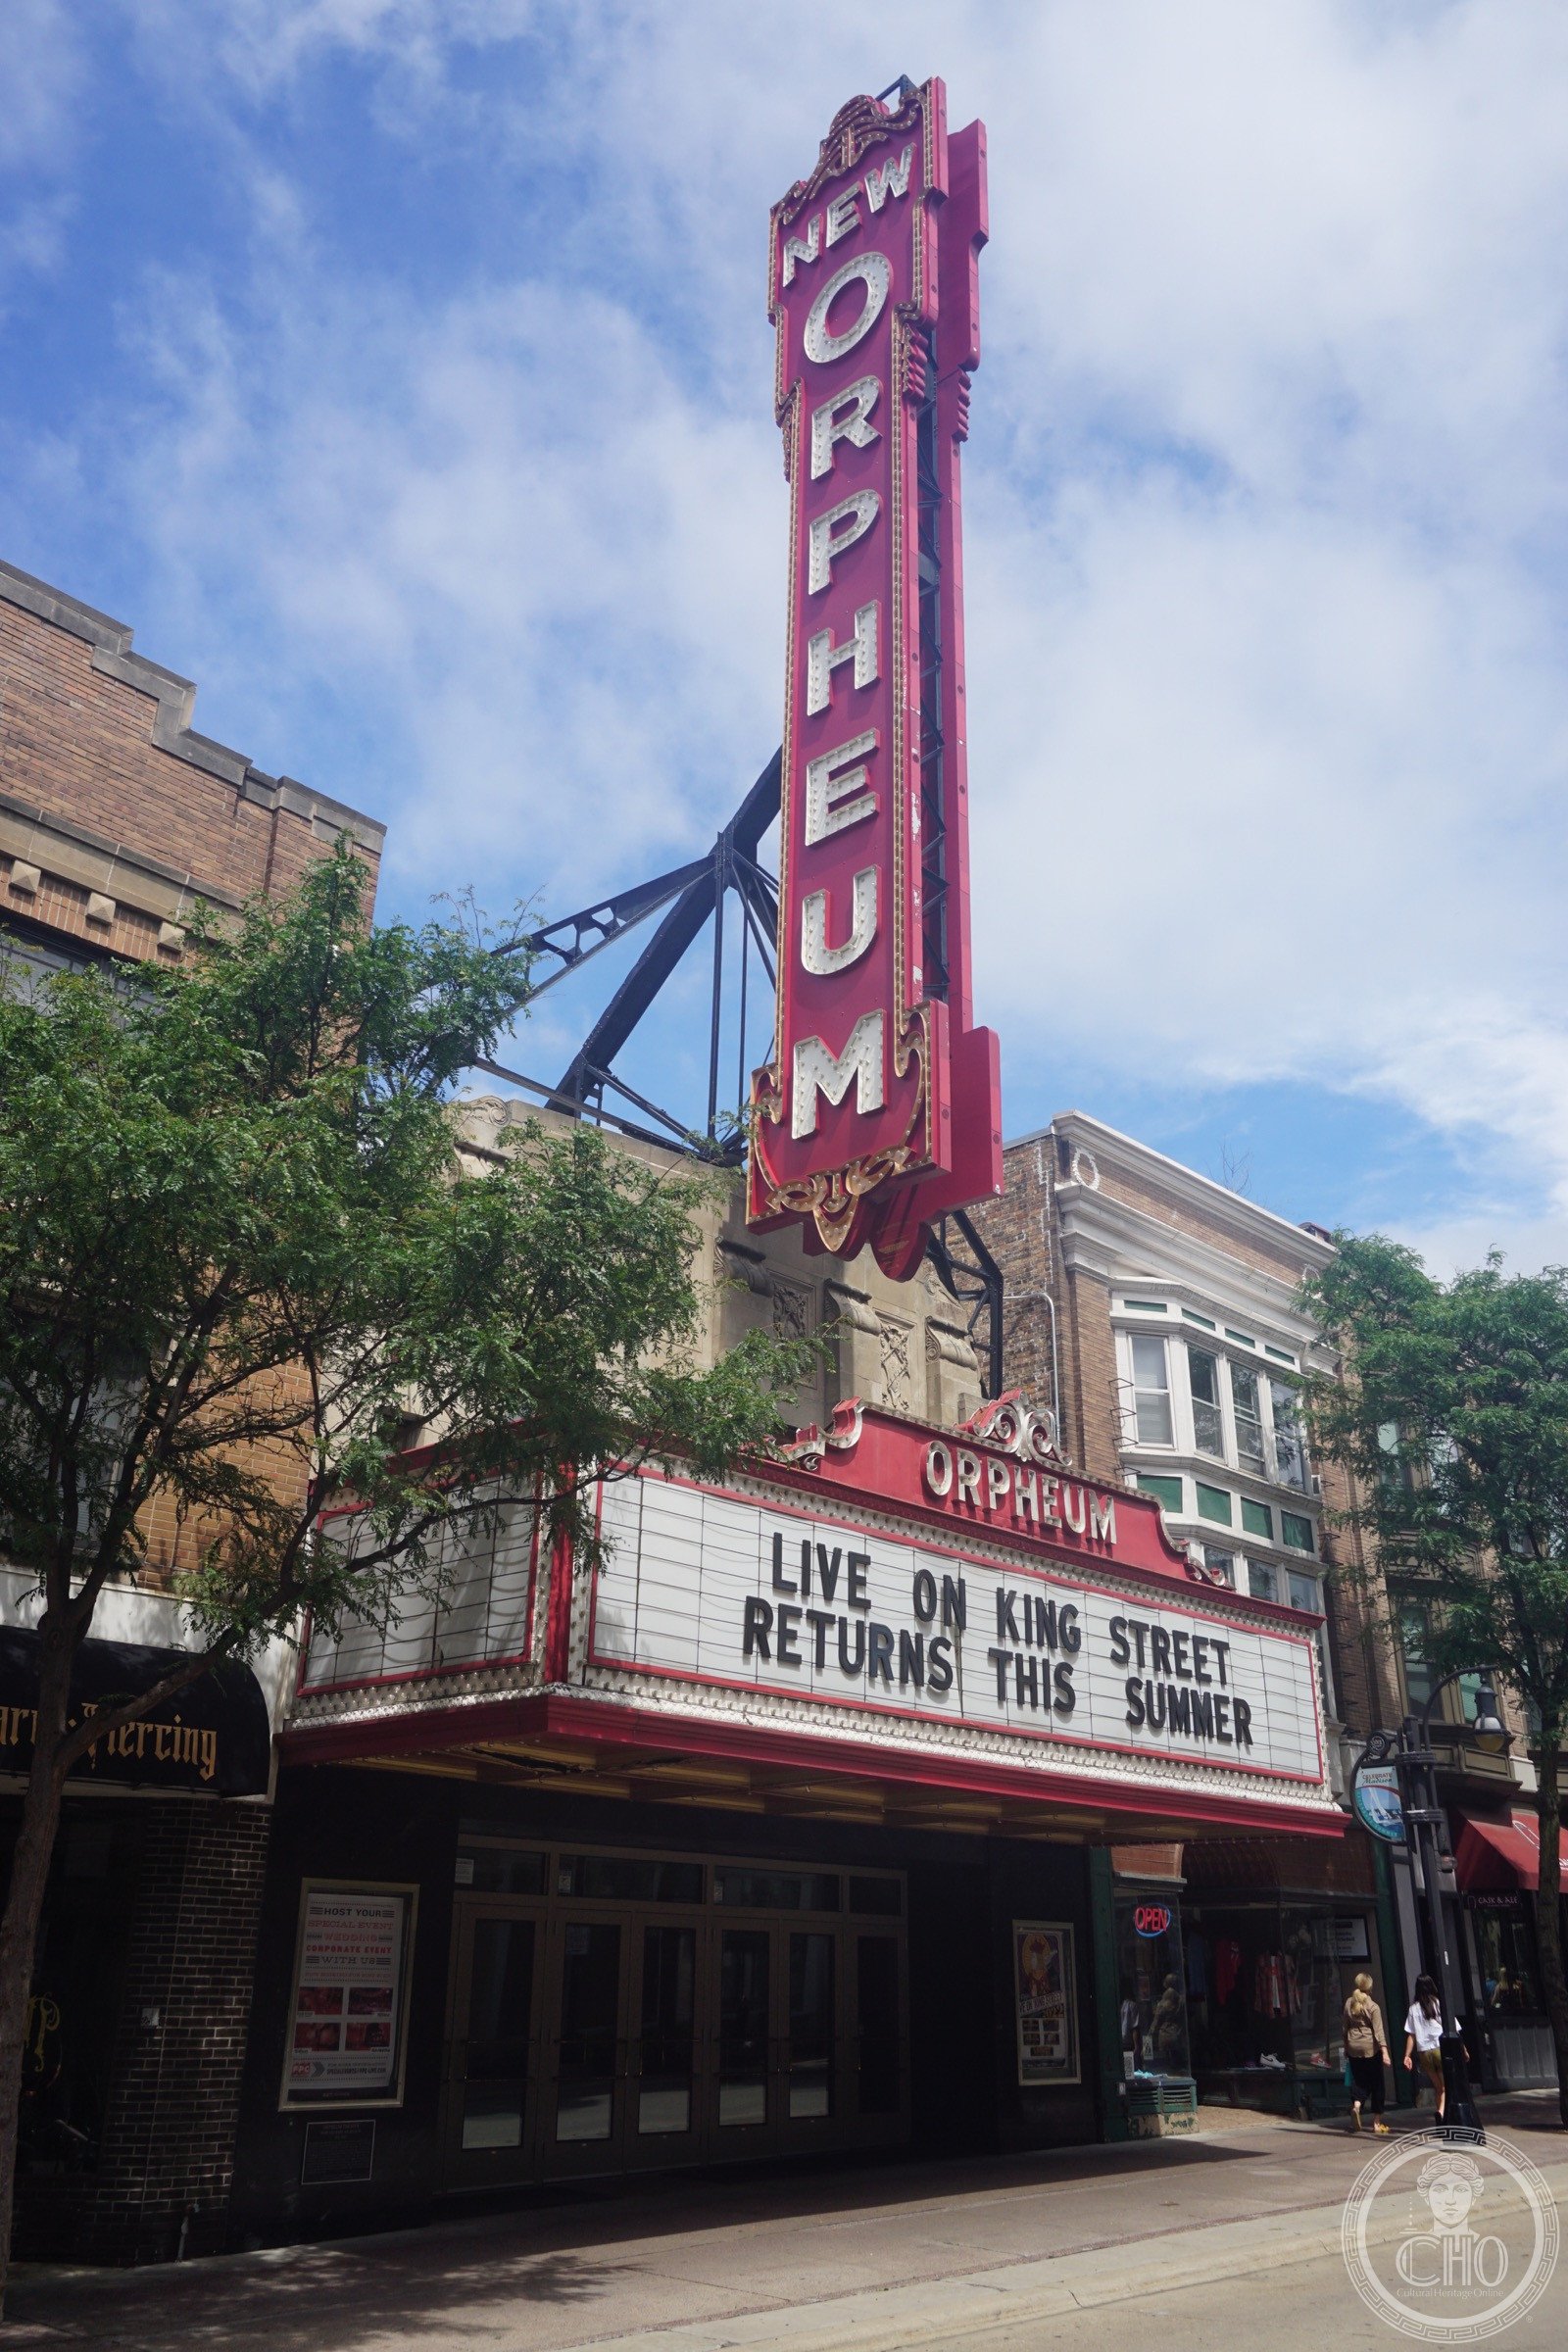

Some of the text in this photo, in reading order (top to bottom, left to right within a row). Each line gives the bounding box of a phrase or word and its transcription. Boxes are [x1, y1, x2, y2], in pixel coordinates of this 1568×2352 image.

[782, 142, 916, 288] NEW
[791, 251, 893, 1140] ORPHEUM
[922, 1441, 1117, 1544] ORPHEUM
[772, 1532, 1230, 1686] LIVE ON KING STREET
[743, 1595, 1253, 1745] RETURNS THIS SUMMER
[307, 1920, 394, 1930] SPECIAL EVENT
[323, 1907, 381, 1918] HOST YOUR
[1135, 1906, 1168, 1932] OPEN
[306, 1944, 392, 1954] CORPORATE EVENT
[323, 1933, 377, 1942] WEDDING
[321, 1956, 357, 1965] WITH
